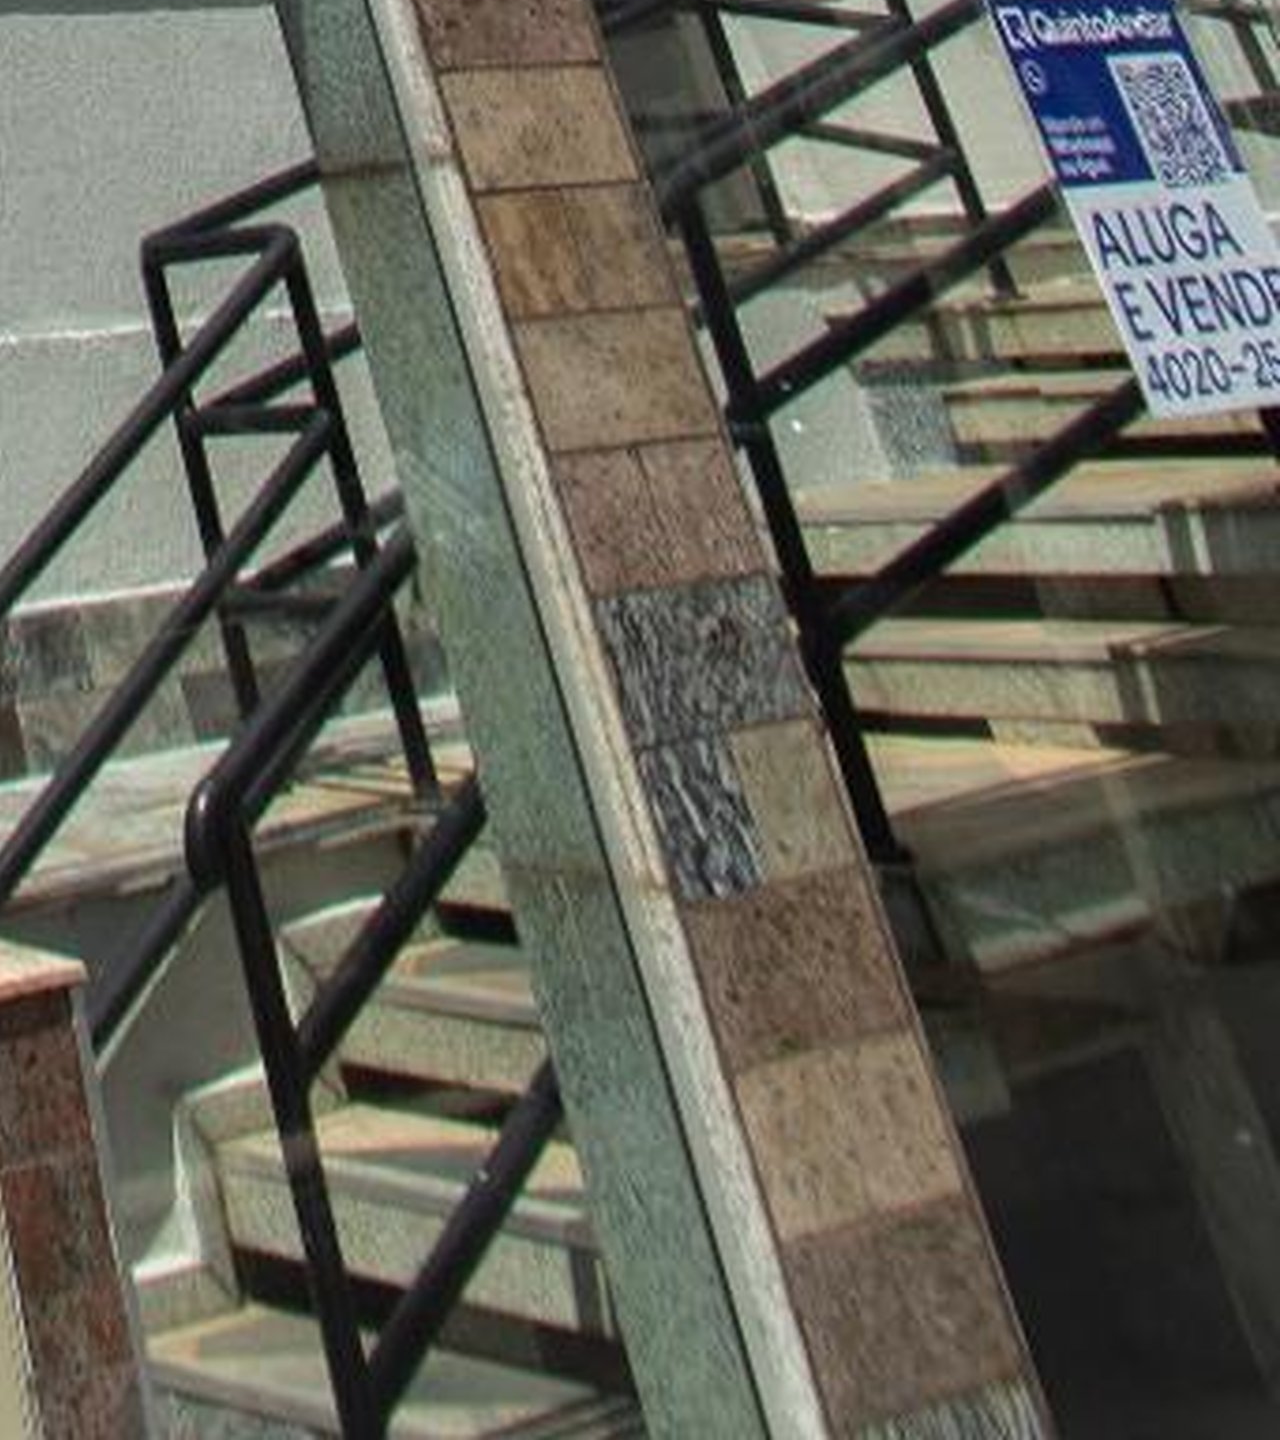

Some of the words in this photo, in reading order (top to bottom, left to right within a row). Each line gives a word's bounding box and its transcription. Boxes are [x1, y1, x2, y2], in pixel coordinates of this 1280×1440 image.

[1029, 6, 1174, 45] QuintoAndar
[1092, 202, 1245, 269] ALUGA
[1113, 281, 1155, 342] E
